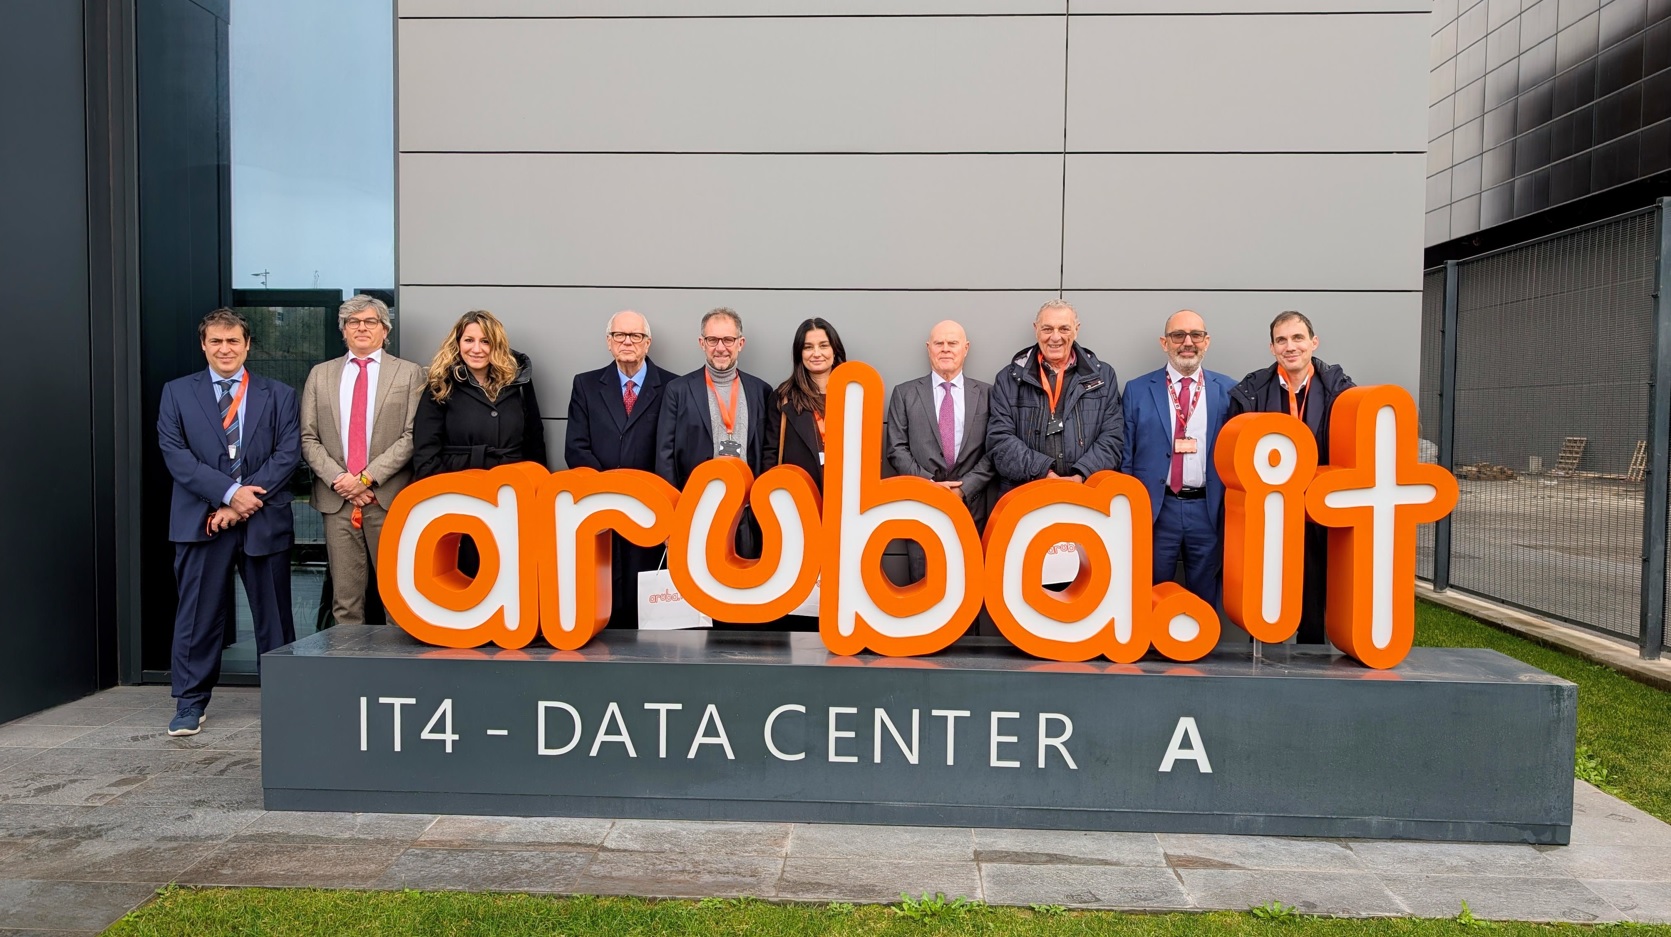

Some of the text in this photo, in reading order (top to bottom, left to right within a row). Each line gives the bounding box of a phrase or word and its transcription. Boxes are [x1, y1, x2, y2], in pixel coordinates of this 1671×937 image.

[378, 361, 1459, 669] aruba.it
[1047, 542, 1077, 555] arub
[648, 588, 683, 604] aruba.
[360, 696, 459, 753] IT4
[537, 700, 736, 760] DATA
[763, 703, 1079, 770] CENTER
[1158, 716, 1213, 774] A
